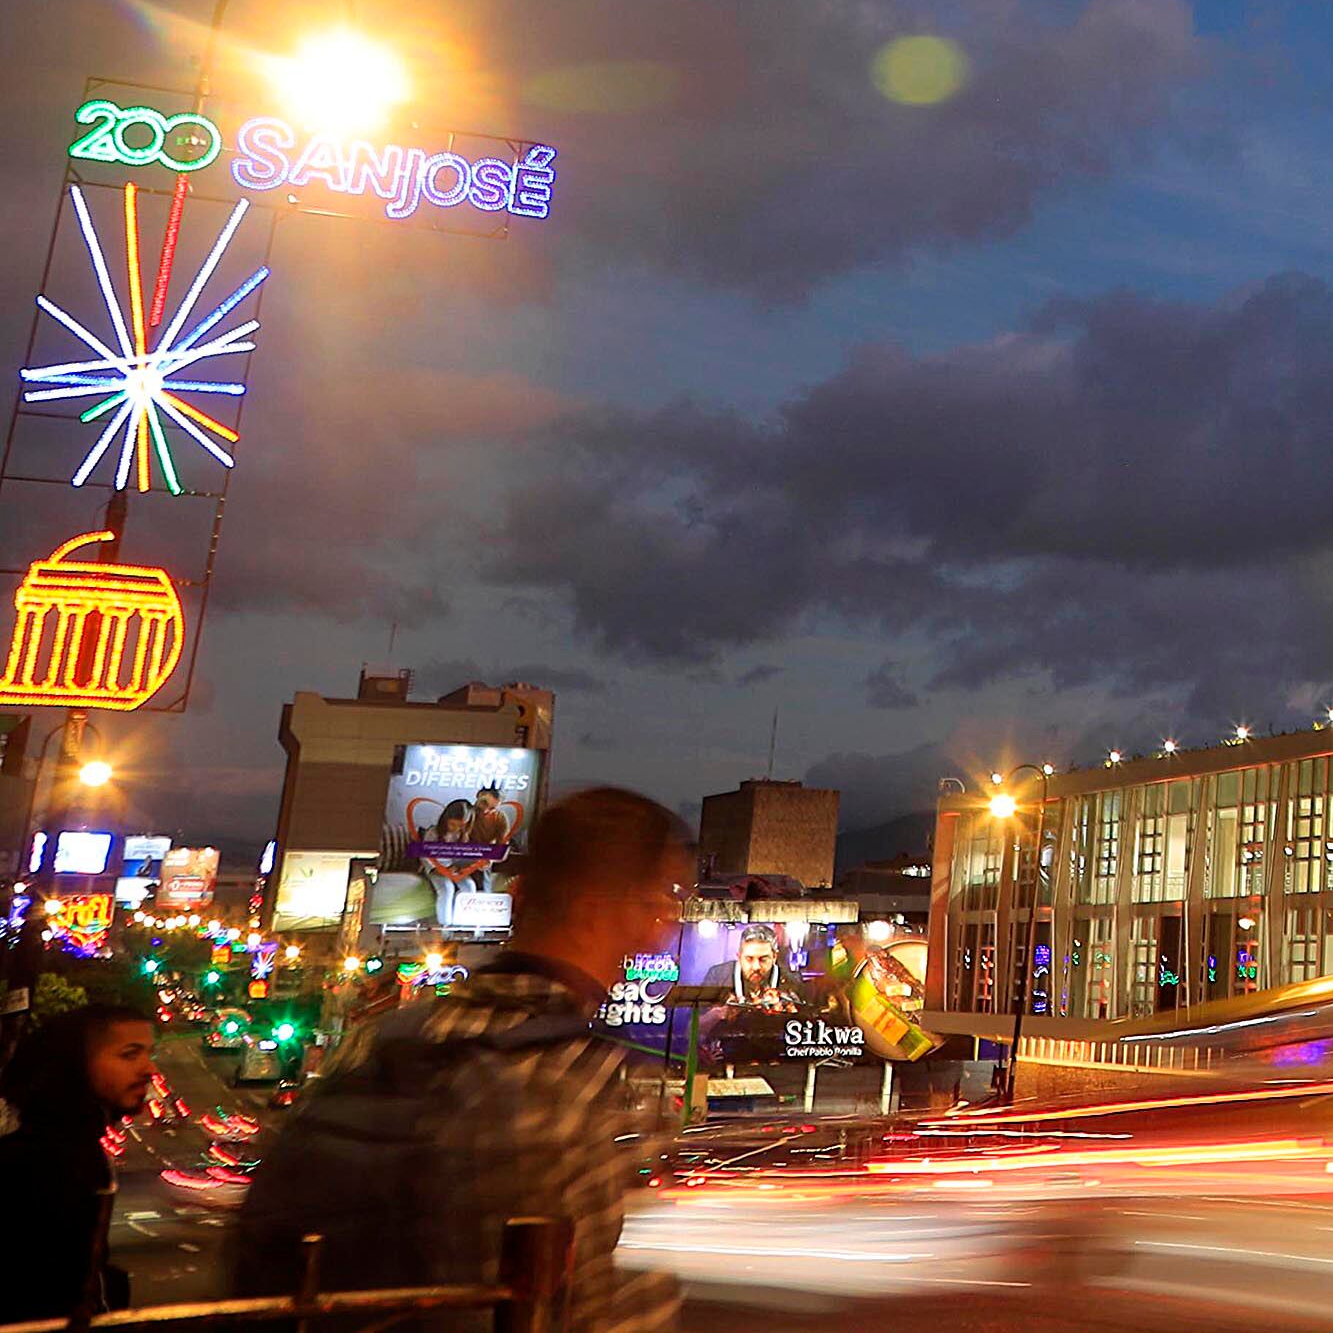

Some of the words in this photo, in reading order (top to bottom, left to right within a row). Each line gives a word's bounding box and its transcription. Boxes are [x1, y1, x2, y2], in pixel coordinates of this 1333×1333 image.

[69, 99, 222, 173] 200
[423, 753, 509, 774] HECHOS
[405, 771, 529, 790] DIFERENTES
[784, 1019, 865, 1045] Sikwa
[786, 1046, 809, 1057] Chef
[809, 1046, 833, 1057] Pablo
